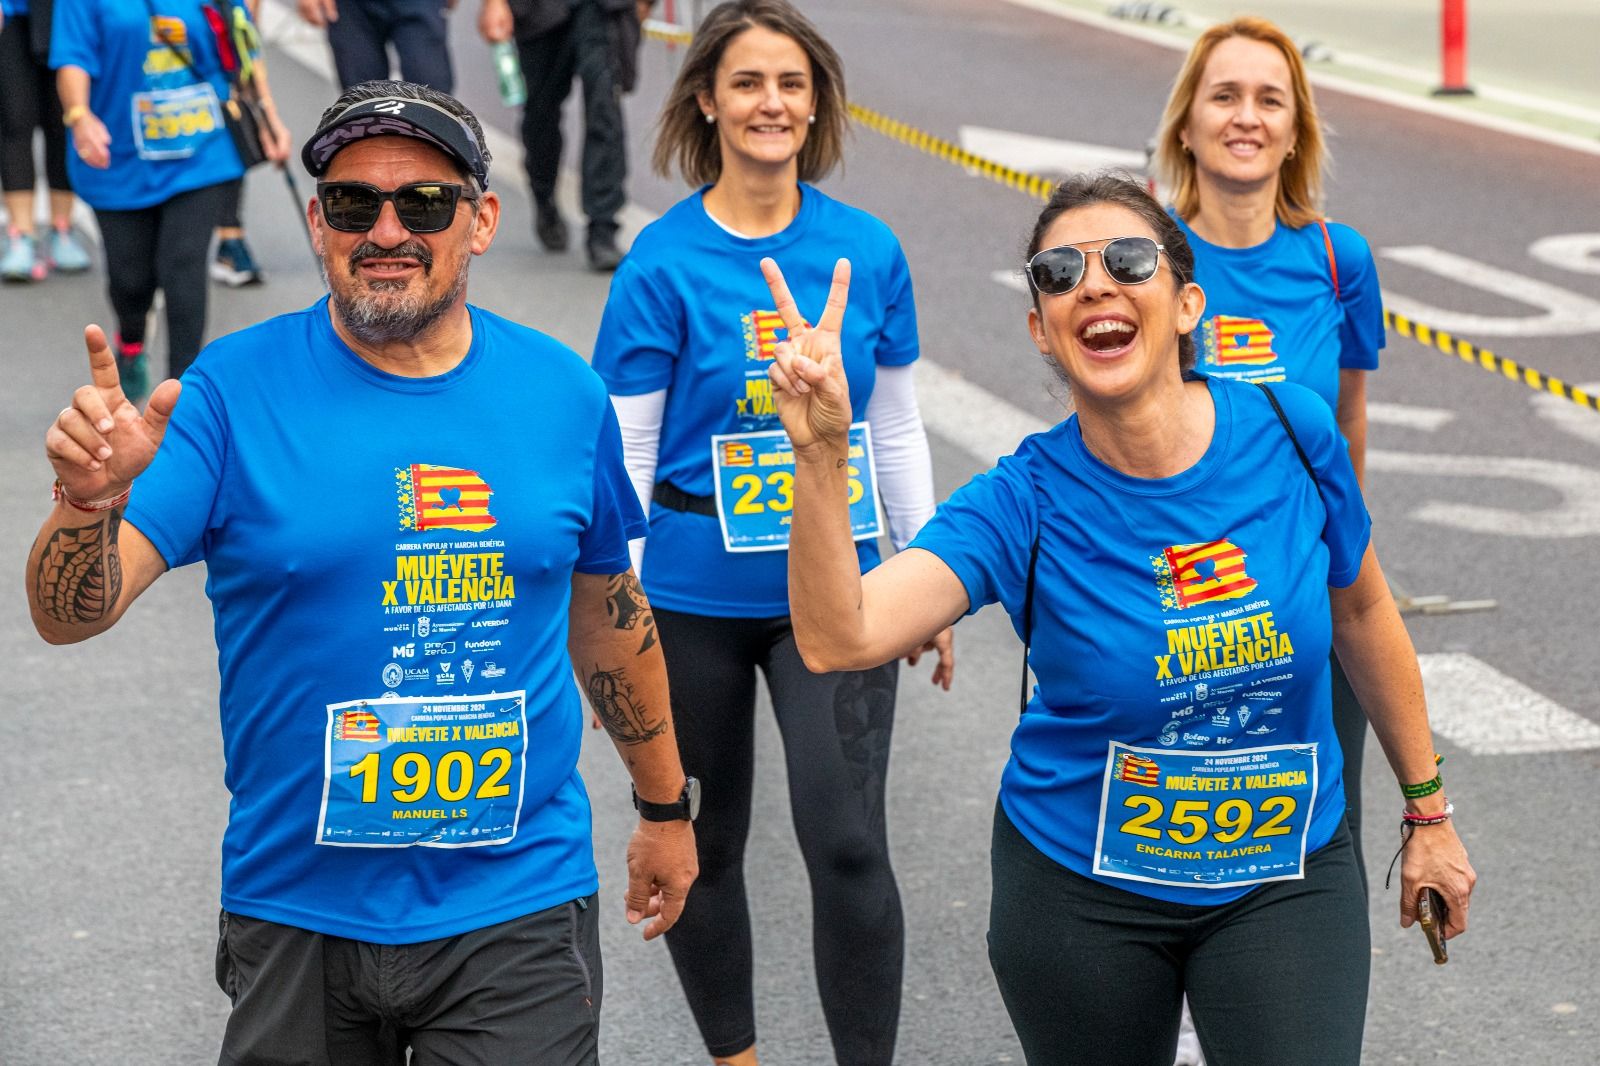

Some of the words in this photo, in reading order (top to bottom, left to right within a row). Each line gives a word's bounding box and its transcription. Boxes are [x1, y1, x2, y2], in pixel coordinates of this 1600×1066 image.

[732, 465, 864, 514] 236
[396, 543, 421, 551] CARRERA
[423, 542, 448, 550] POPULAR
[454, 541, 478, 549] MARCHA
[480, 539, 505, 548] BENÉFICA
[396, 550, 504, 580] MUÉVETE
[382, 581, 398, 606] X
[404, 576, 516, 605] VALENCIA
[385, 606, 390, 614] A
[392, 606, 412, 614] FAVOR
[414, 605, 421, 613] DE
[436, 603, 472, 612] AFECTADOS
[474, 602, 486, 610] POR
[488, 601, 494, 609] LA
[496, 600, 512, 608] DANA
[1221, 607, 1244, 618] MARCHA
[1244, 600, 1270, 612] BENÉFICA
[482, 619, 509, 627] VERDAD
[1167, 612, 1278, 654] MUÉVETE
[1154, 655, 1173, 680] X
[1178, 632, 1294, 676] VALENCIA
[1166, 676, 1187, 686] FAVOR
[1189, 674, 1197, 682] DE
[1198, 671, 1212, 680] LOS
[1212, 665, 1250, 678] AFECTADOS
[1251, 663, 1264, 671] POR
[1266, 660, 1274, 668] LA
[1274, 656, 1292, 666] DANA
[422, 705, 431, 713] 24
[433, 704, 469, 713] NOVIEMBRE
[470, 704, 485, 712] 2024
[387, 724, 448, 742] MUÉVETE
[452, 726, 461, 741] X
[464, 721, 519, 740] VALENCIA
[1214, 756, 1250, 766] NOVIEMBRE
[1252, 754, 1268, 762] 2024
[350, 748, 512, 803] 1902
[1166, 774, 1229, 792] MUÉVETE
[1232, 776, 1242, 791] X
[1246, 770, 1307, 789] VALENCIA
[392, 809, 447, 820] MANUEL
[452, 809, 468, 818] LS
[1119, 794, 1297, 844] 2592
[1136, 844, 1202, 860] ENCARNA
[1206, 844, 1272, 860] TALAVERA
